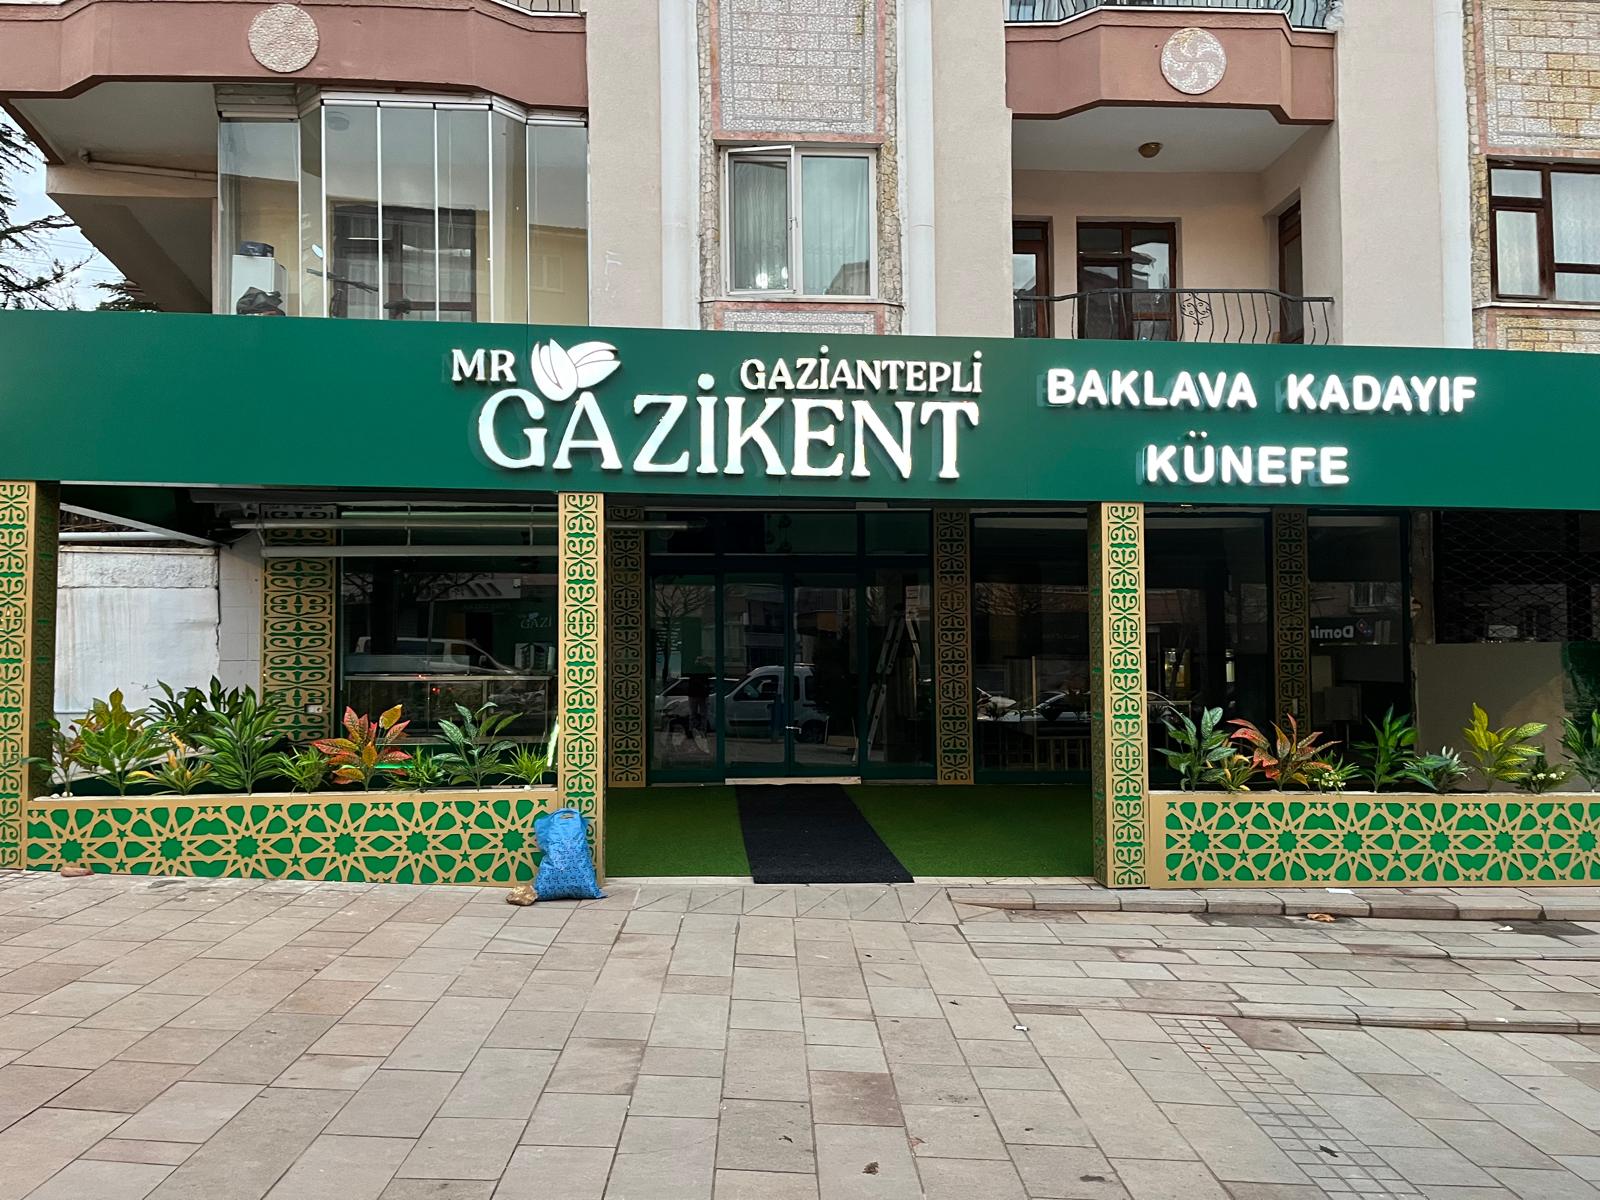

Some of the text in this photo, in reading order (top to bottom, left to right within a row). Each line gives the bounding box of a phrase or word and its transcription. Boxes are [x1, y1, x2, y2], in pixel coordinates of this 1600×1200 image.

[452, 349, 516, 382] MR
[740, 344, 982, 393] GAZİANTEPLİ
[1047, 368, 1477, 413] BAKLAVA KADAYIF
[478, 373, 980, 479] GAZİKENT
[1146, 429, 1350, 485] KÜNEFE
